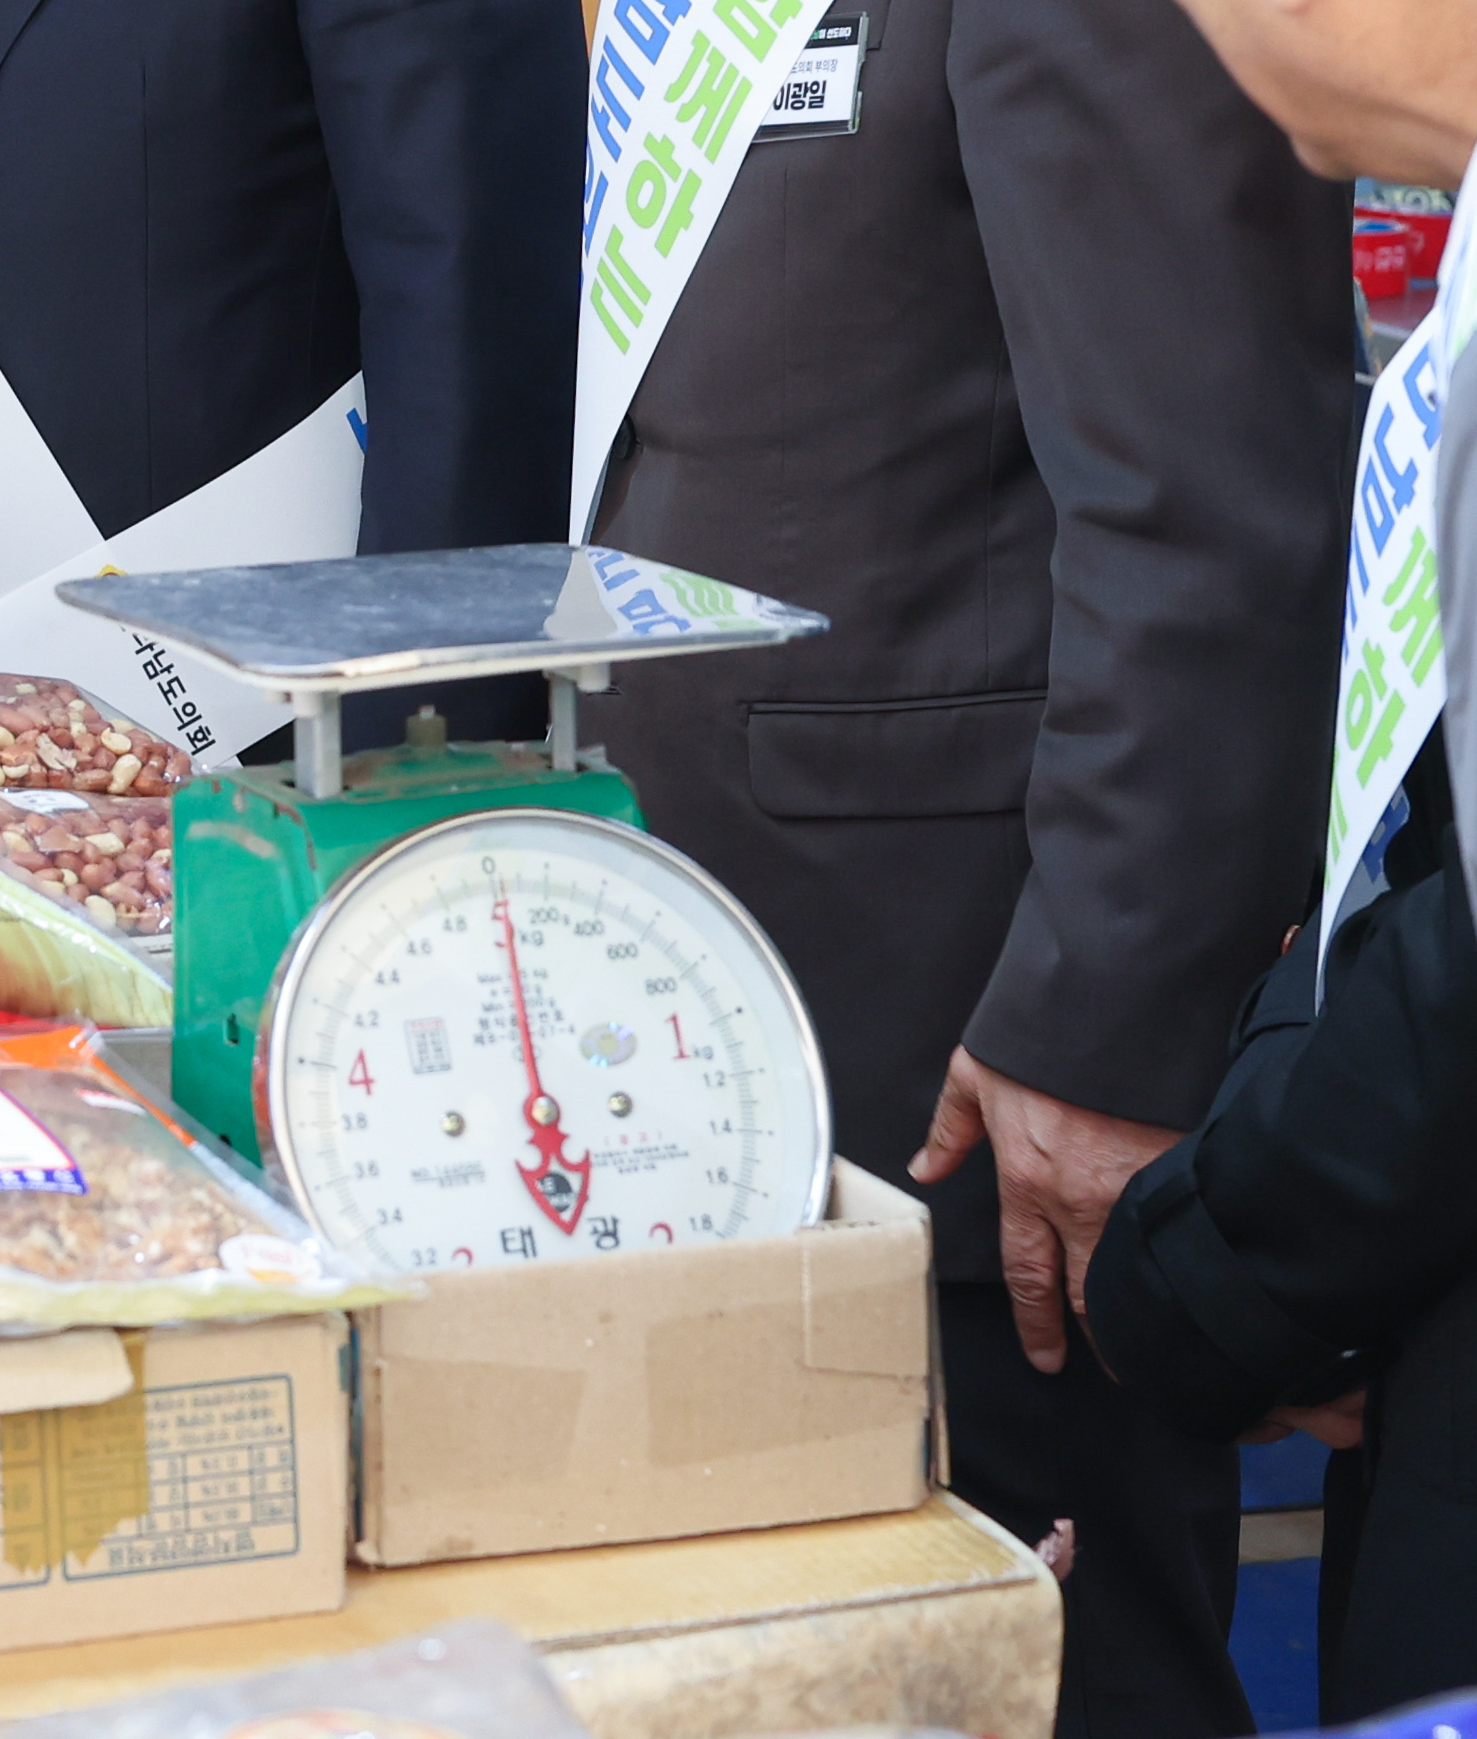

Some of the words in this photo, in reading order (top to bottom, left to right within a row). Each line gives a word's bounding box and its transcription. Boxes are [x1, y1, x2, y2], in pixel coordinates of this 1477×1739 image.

[815, 58, 839, 73] 부의장
[773, 80, 827, 111] 이광일
[481, 856, 496, 874] 0
[442, 916, 468, 932] 4.8
[573, 920, 605, 939] 400
[406, 939, 433, 957] 4.6
[606, 942, 638, 961] 600
[374, 969, 401, 987] 4.4
[645, 977, 678, 996] 800
[354, 1010, 380, 1029] 4.2
[663, 1012, 692, 1062] 1
[346, 1049, 377, 1096] 4
[702, 1070, 727, 1089] 1.2
[341, 1113, 369, 1131] 3.8
[708, 1118, 733, 1137] 1.4
[354, 1161, 380, 1179] 3.6
[705, 1166, 730, 1185] 1.6
[376, 1207, 403, 1226] 3.4
[689, 1214, 714, 1233] 1.8
[500, 1226, 539, 1260] 태
[586, 1215, 623, 1251] 광
[410, 1248, 439, 1267] 3.2
